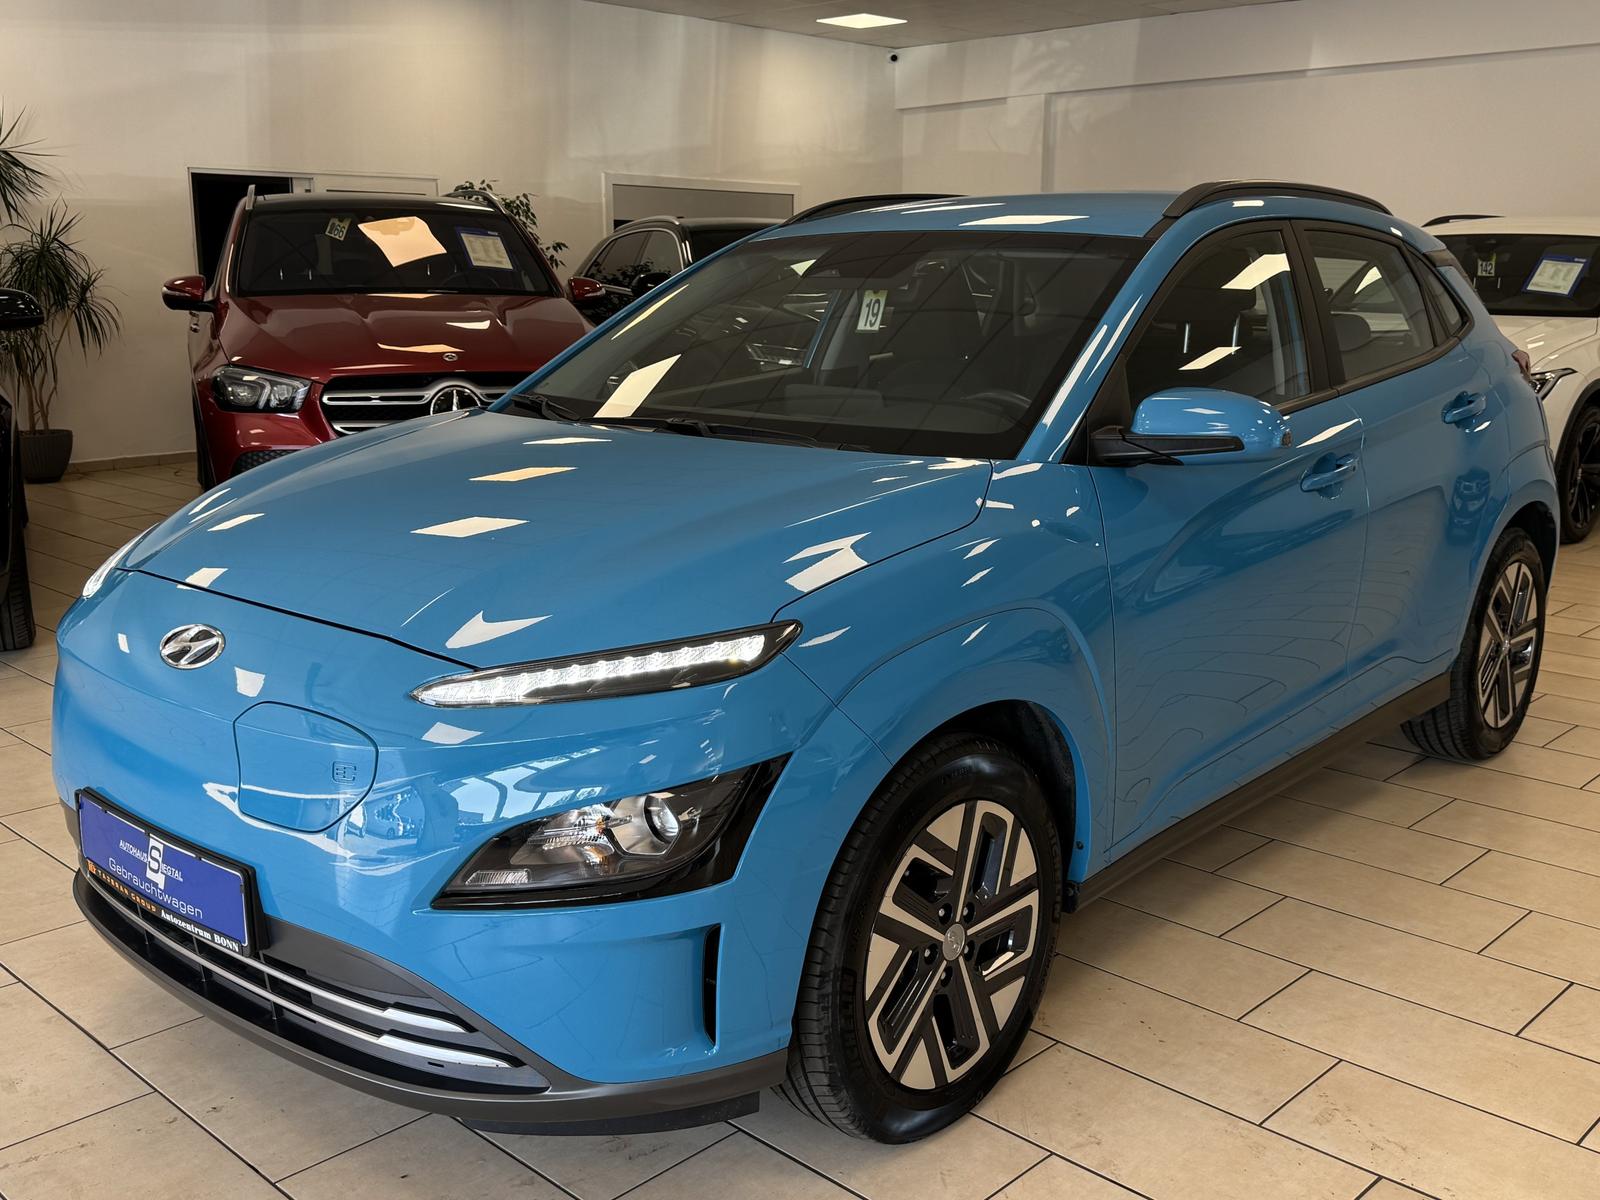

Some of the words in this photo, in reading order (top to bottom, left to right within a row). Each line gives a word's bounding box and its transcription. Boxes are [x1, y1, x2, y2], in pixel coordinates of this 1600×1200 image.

[1479, 261, 1494, 275] 142
[864, 298, 881, 328] 19
[119, 839, 148, 862] AUTOHAUS
[148, 845, 183, 881] SIEGTAL
[108, 857, 203, 919] Gebrauchtwagen
[130, 893, 157, 912] GROUP
[160, 909, 212, 940] Autozentrum
[213, 933, 239, 952] BONN
